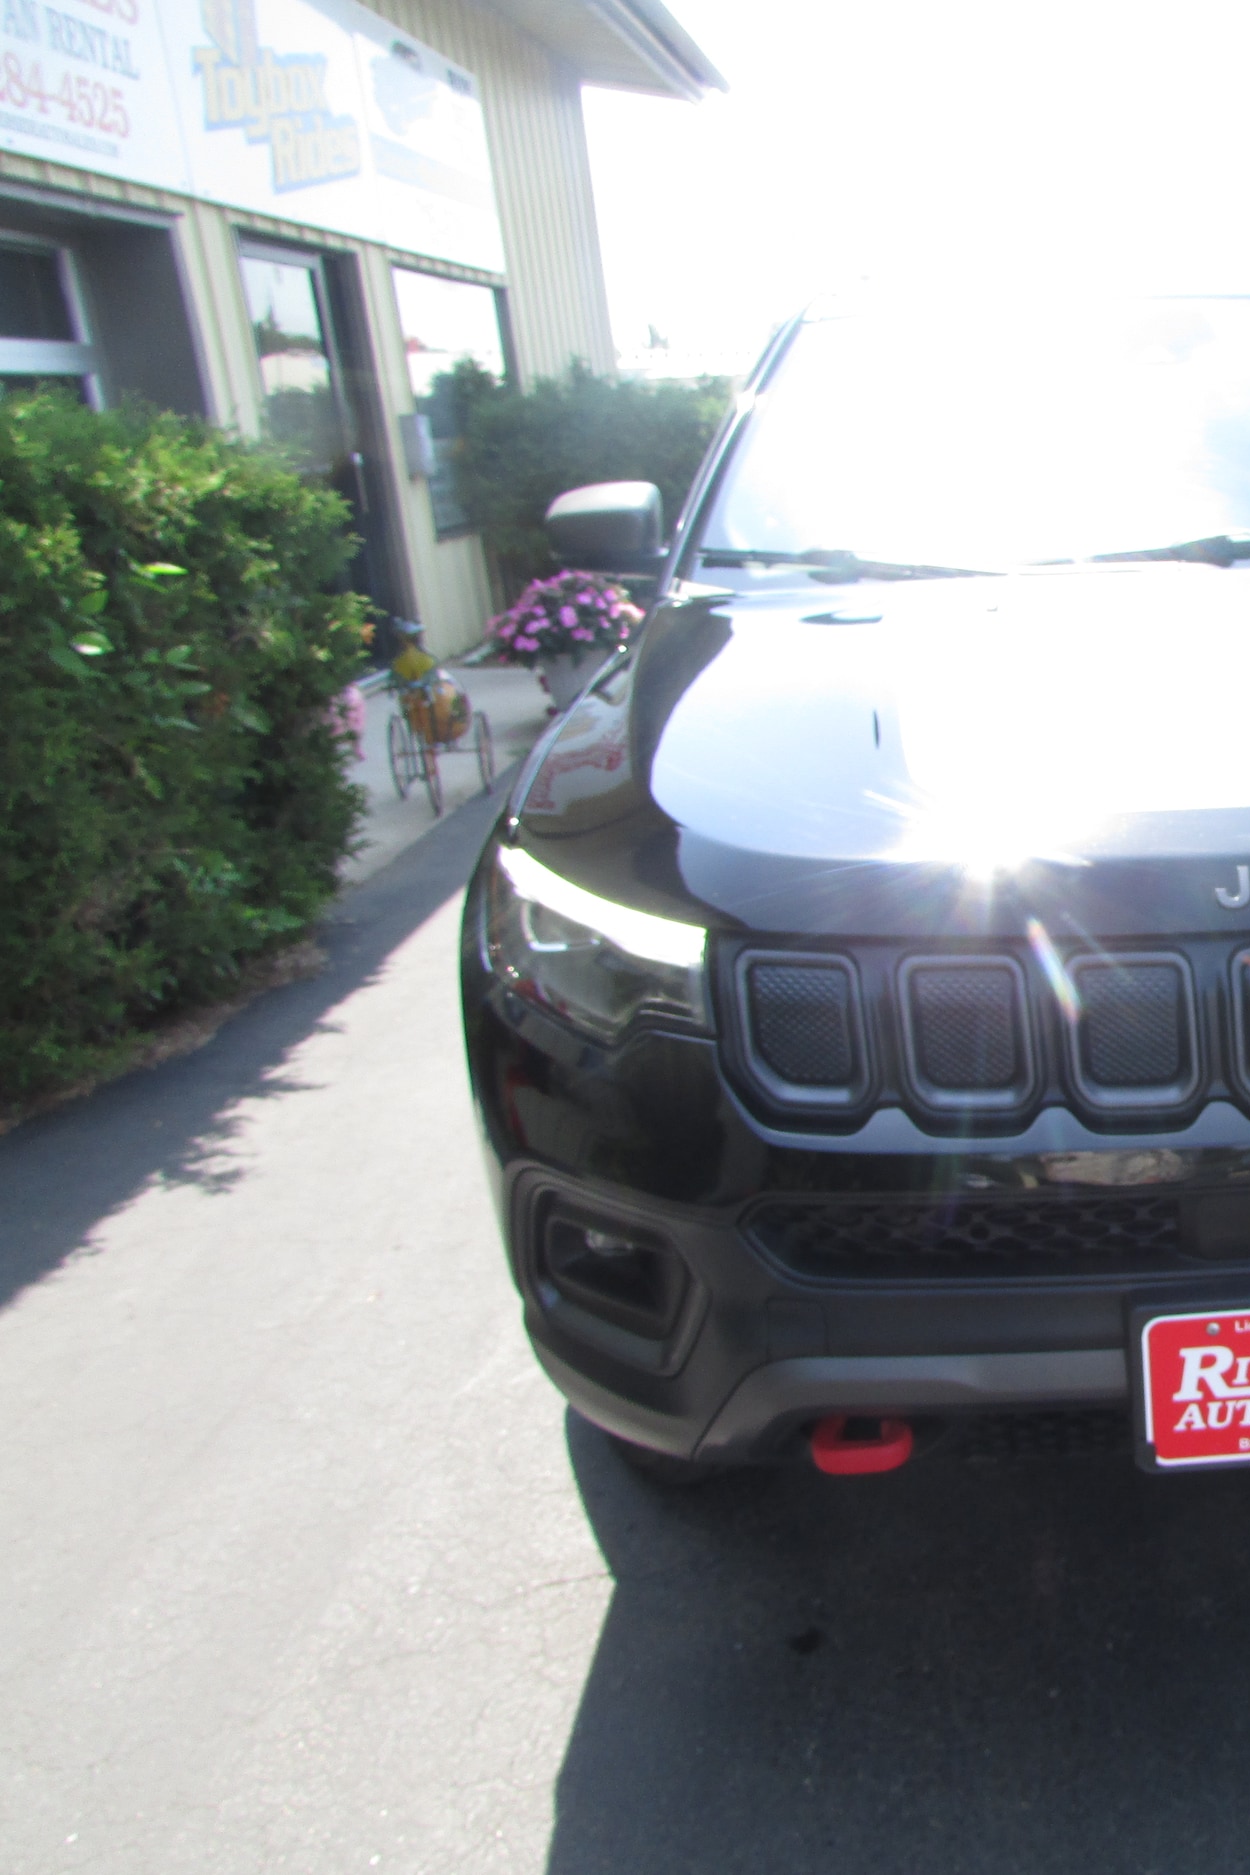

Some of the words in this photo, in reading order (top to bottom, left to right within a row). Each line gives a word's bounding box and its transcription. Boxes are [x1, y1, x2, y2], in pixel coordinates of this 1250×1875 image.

[44, 4, 141, 80] RENTAL
[192, 46, 328, 143] Toybox
[274, 115, 361, 191] Rides
